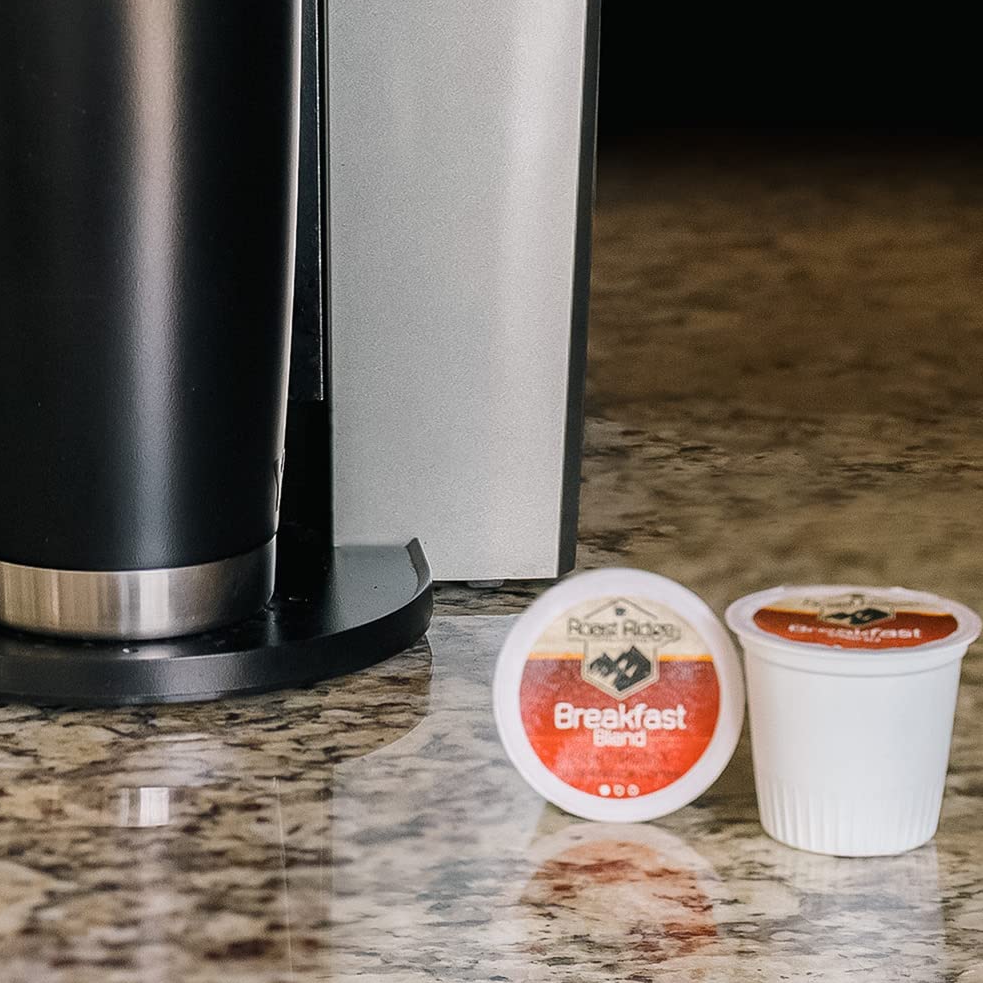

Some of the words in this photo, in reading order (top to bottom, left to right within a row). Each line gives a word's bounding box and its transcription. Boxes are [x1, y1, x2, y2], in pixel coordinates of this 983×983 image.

[568, 618, 618, 636] Roast
[623, 619, 675, 641] Ridge
[553, 701, 687, 731] Breakfast
[592, 728, 648, 748] Blend
